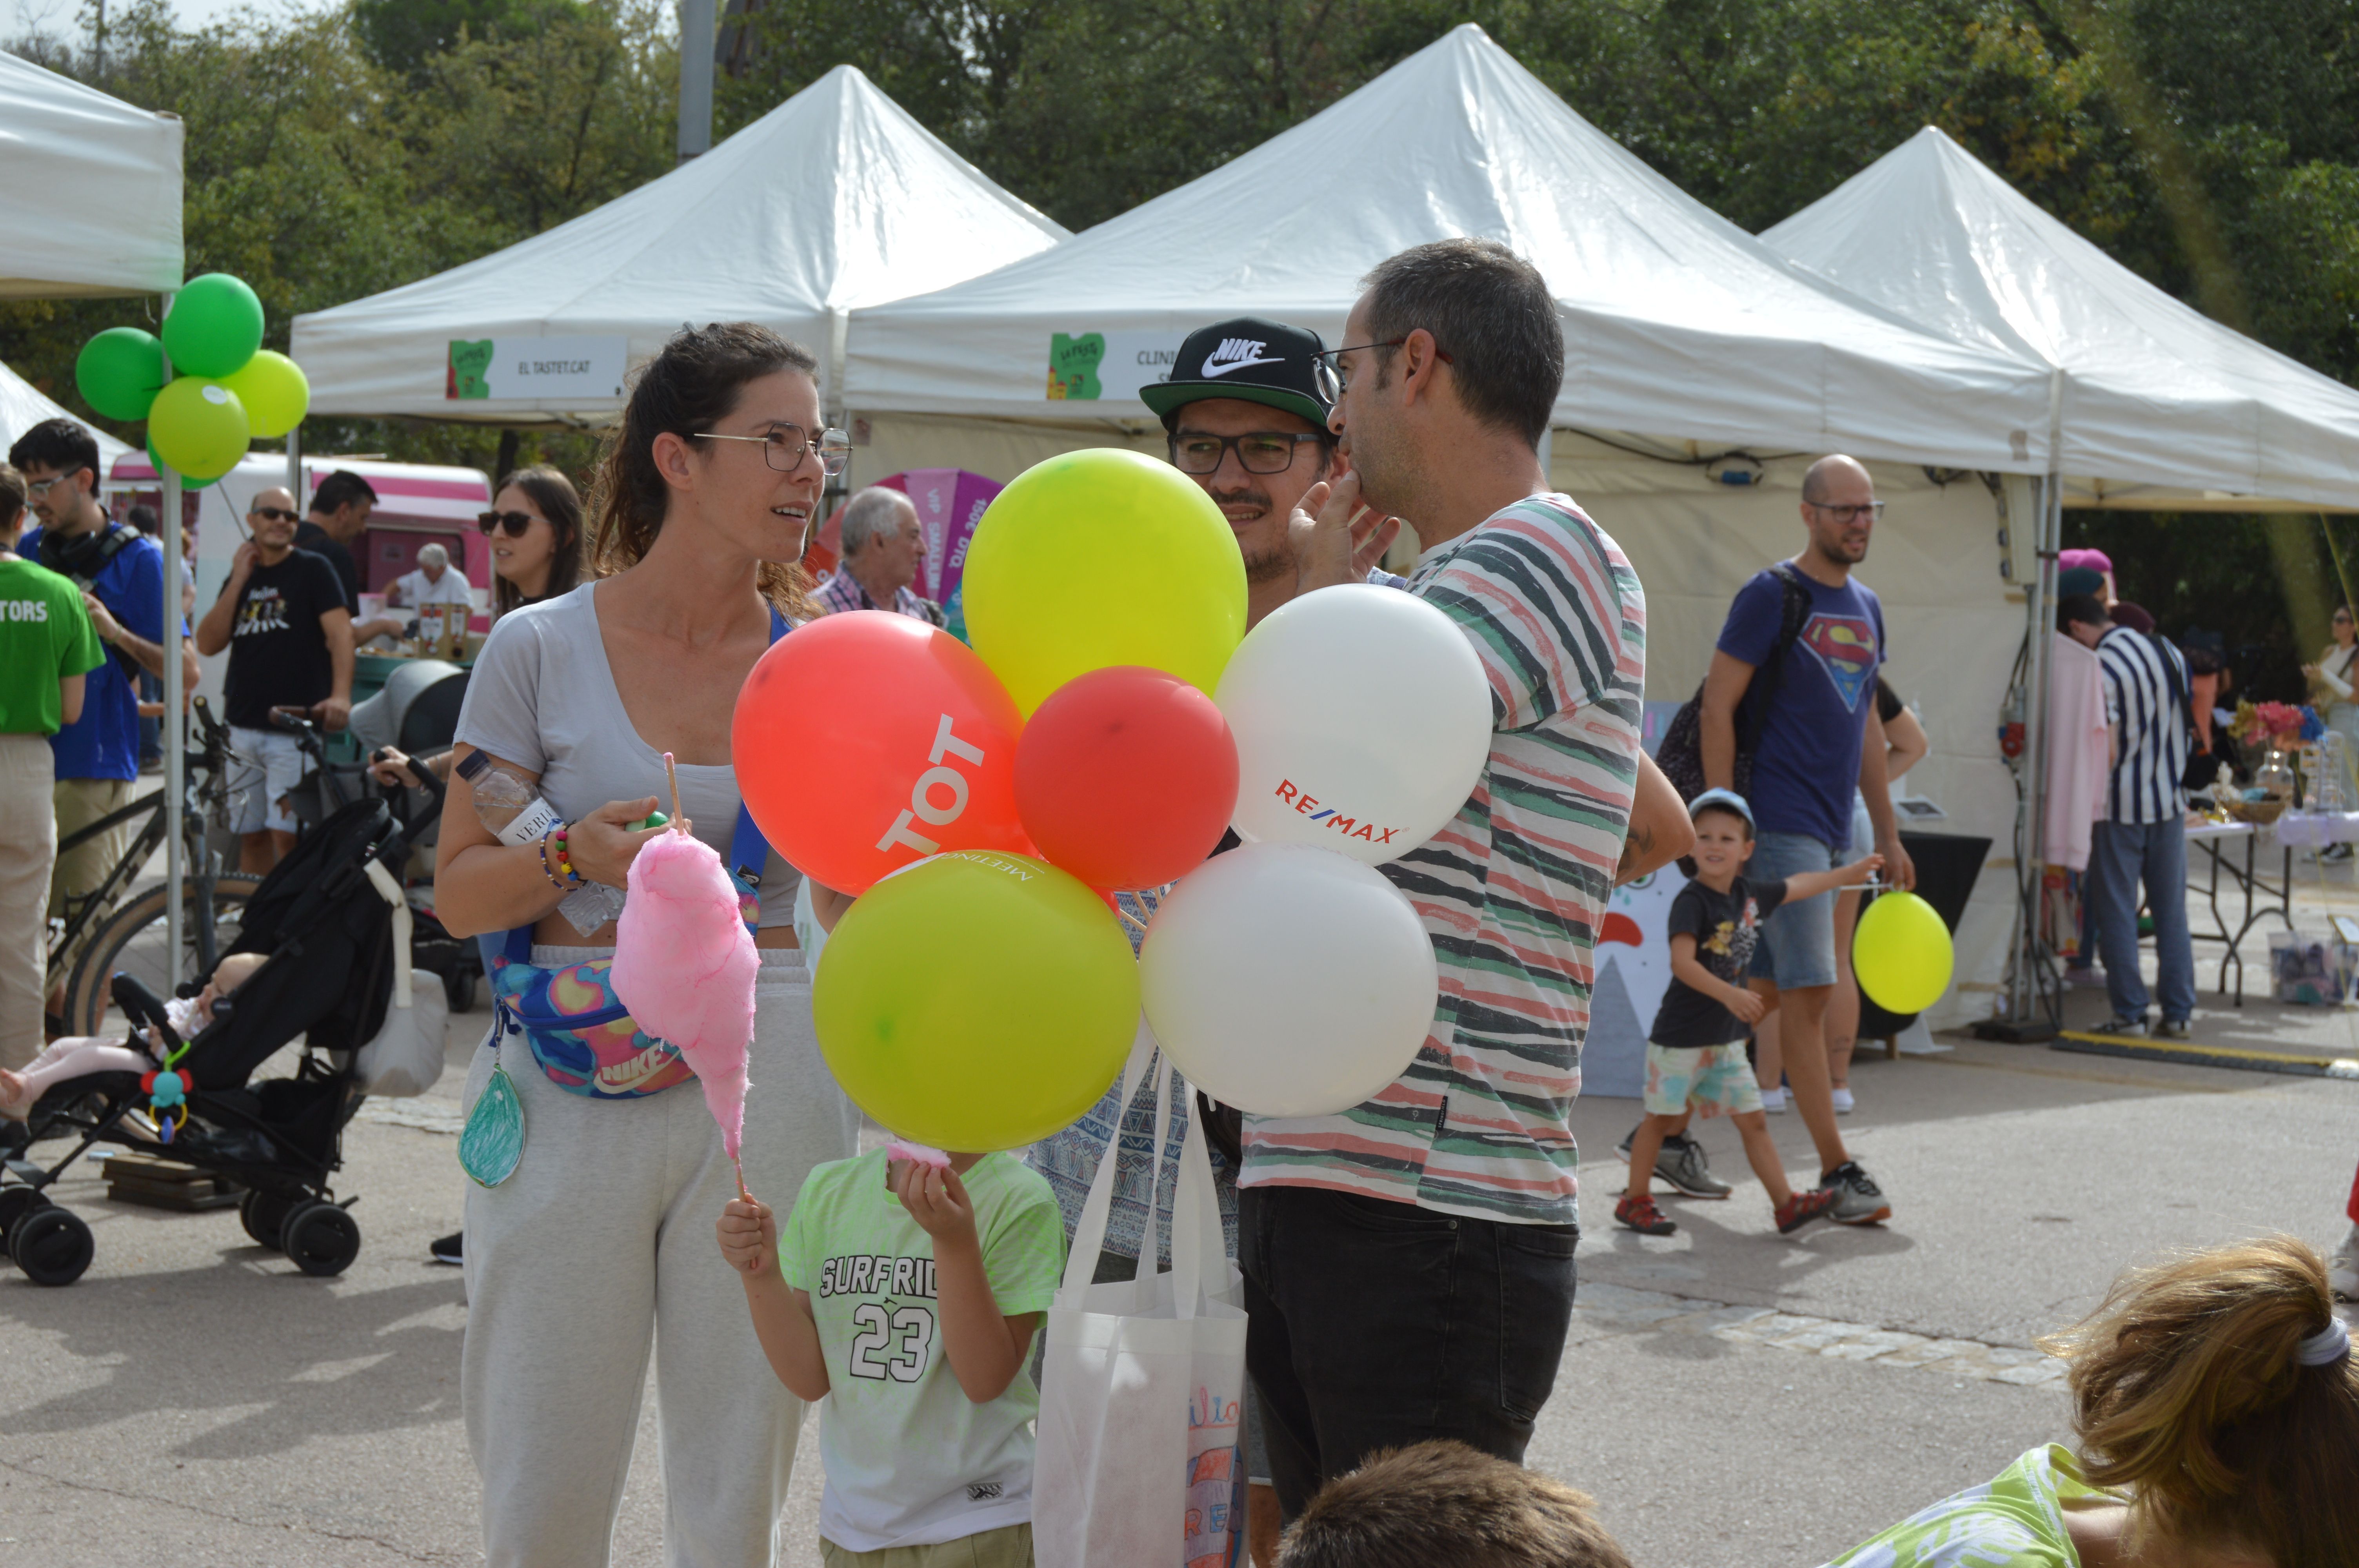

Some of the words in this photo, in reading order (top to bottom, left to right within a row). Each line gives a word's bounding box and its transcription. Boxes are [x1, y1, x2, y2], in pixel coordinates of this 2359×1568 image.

[1137, 350, 1175, 365] CLINI
[1213, 338, 1267, 361] NIKE
[518, 361, 529, 375] EL
[927, 488, 941, 514] VIP
[875, 713, 985, 856] TOT
[941, 852, 1033, 881] MEETING
[601, 1042, 666, 1081] NIKE
[850, 1303, 934, 1383] 23
